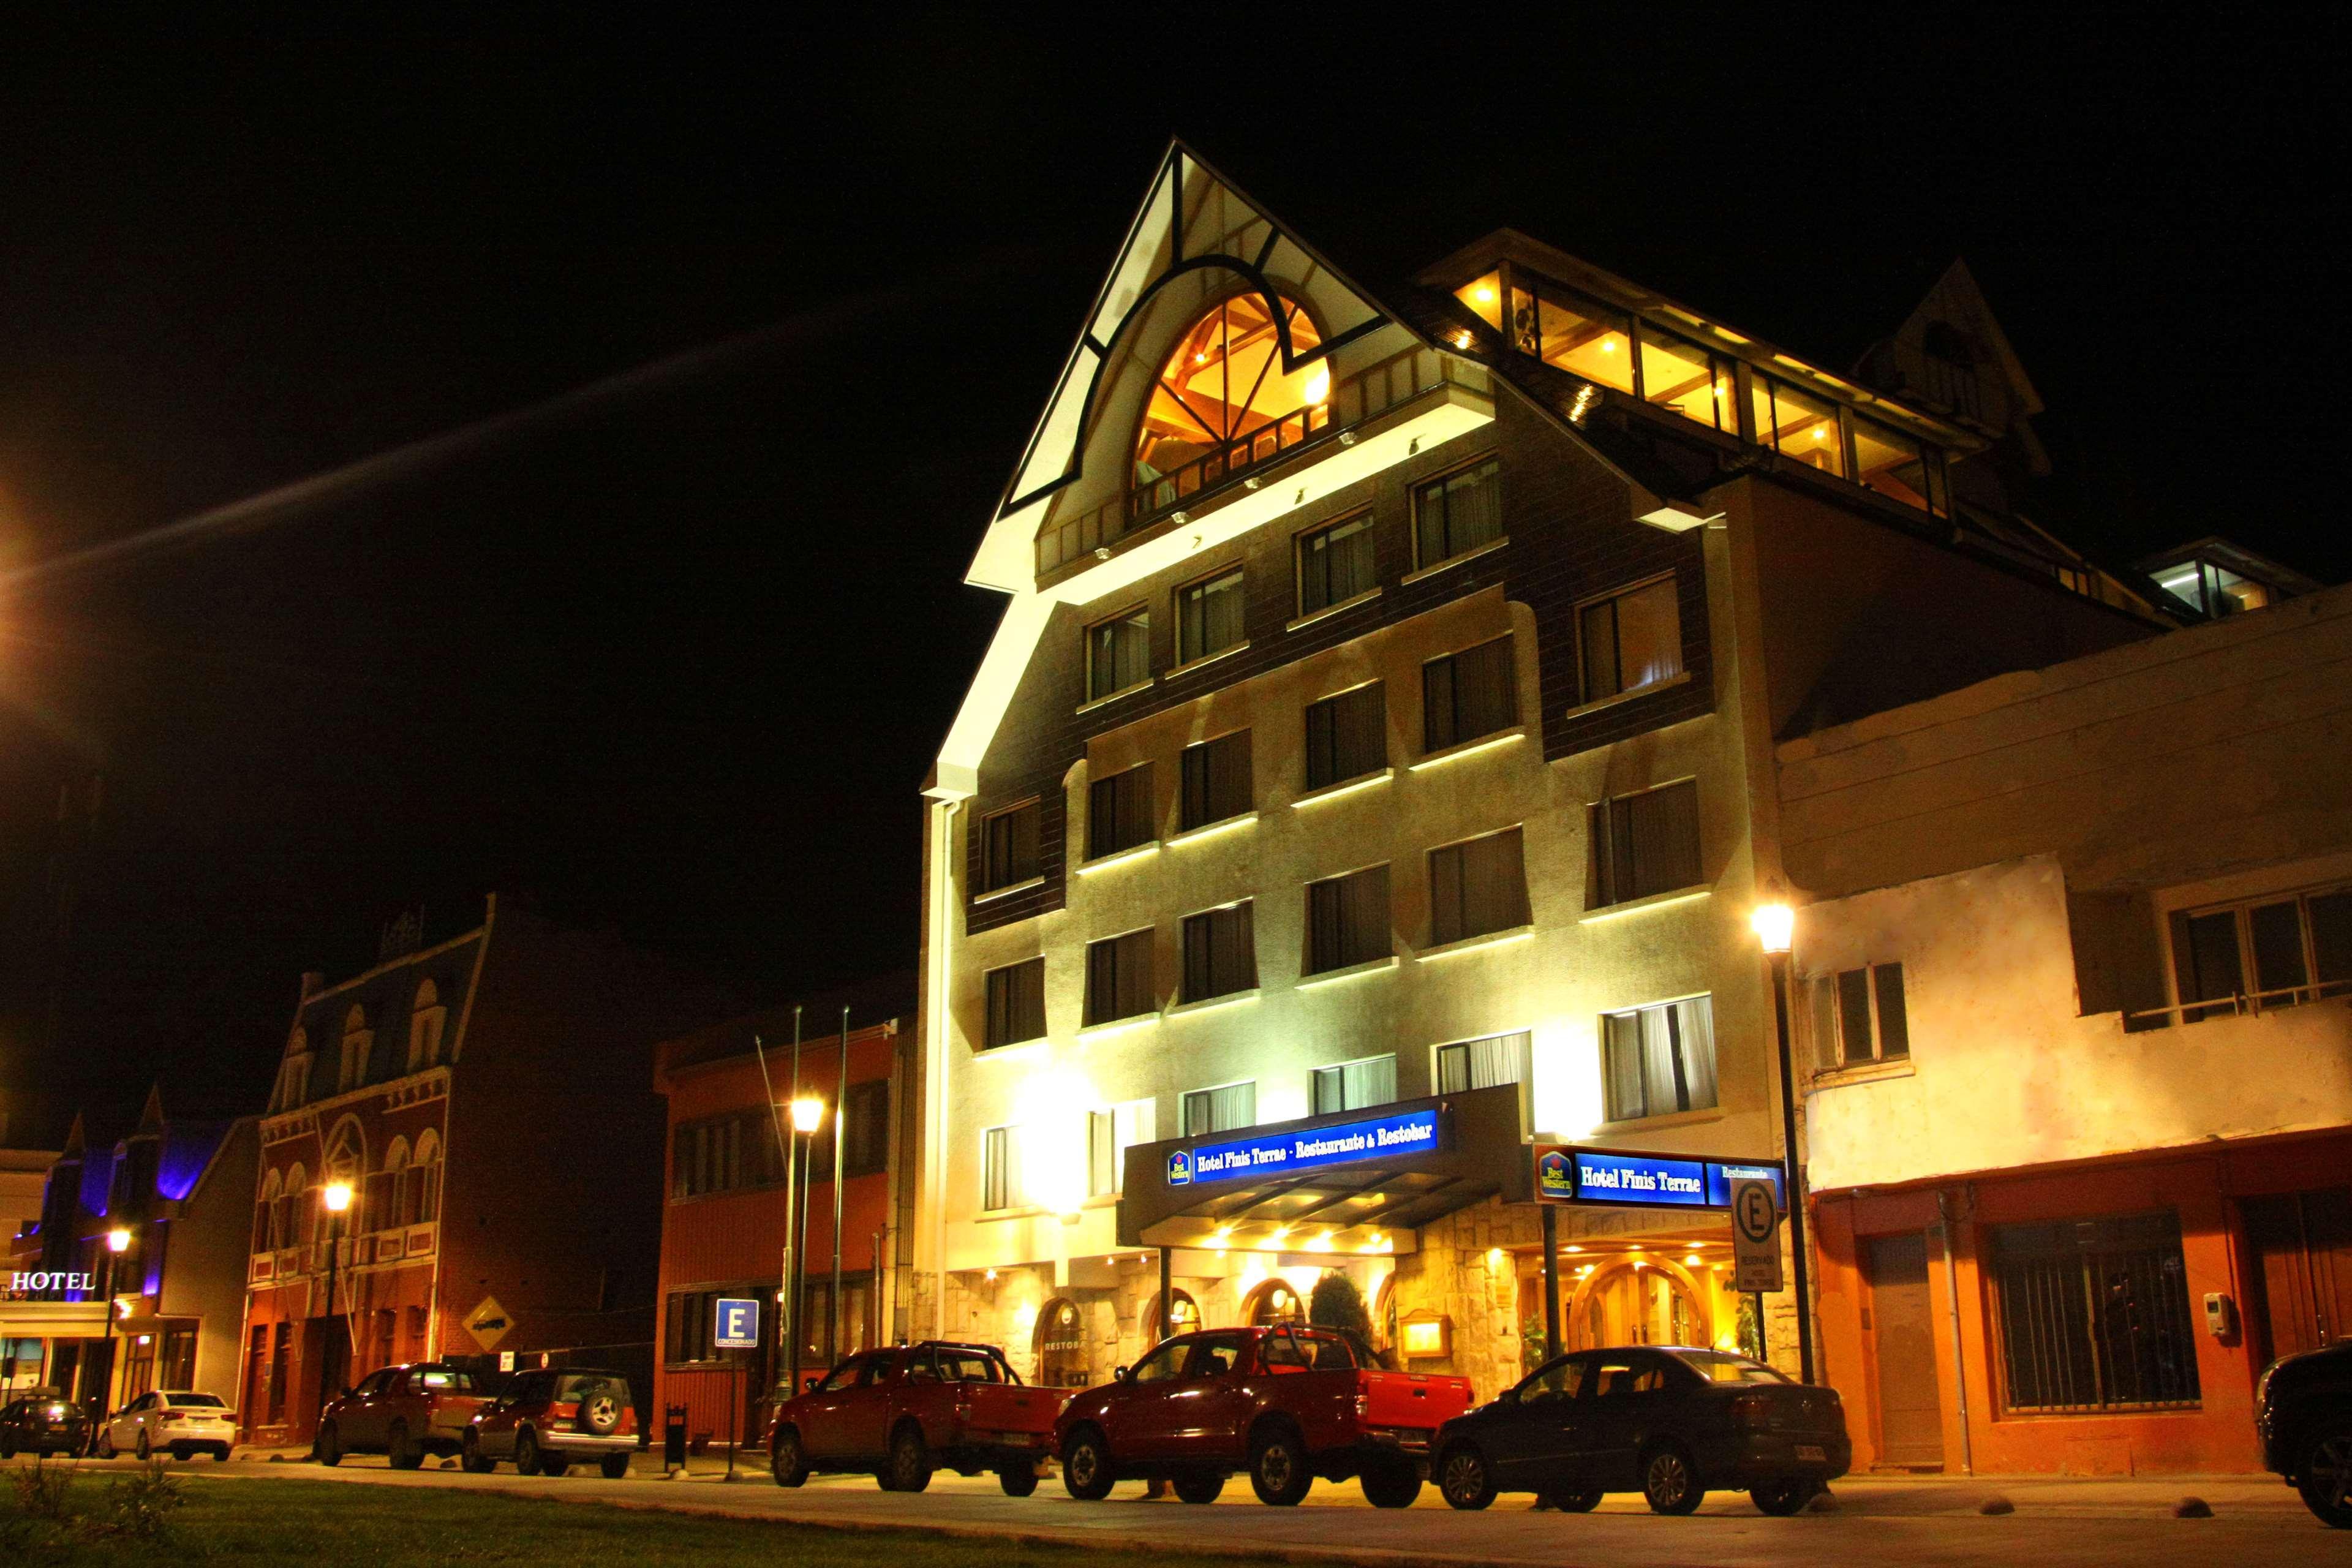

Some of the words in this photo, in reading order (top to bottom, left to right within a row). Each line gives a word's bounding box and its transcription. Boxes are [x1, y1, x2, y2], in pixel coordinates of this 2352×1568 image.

[1197, 1153, 1224, 1173] Hotel
[1224, 1150, 1251, 1169] Finis
[1251, 1148, 1287, 1165] Terrae
[1295, 1133, 1365, 1159] Restaurante
[1366, 1133, 1376, 1149] &
[1377, 1123, 1433, 1147] Restobar
[1174, 1163, 1184, 1172] Best
[1547, 1167, 1563, 1179] Best
[1542, 1176, 1571, 1189] Western
[1580, 1166, 1619, 1188] Hotel
[1620, 1169, 1656, 1190] Finis
[1657, 1171, 1701, 1193] Terrae
[1749, 1193, 1765, 1231] E
[10, 1272, 96, 1290] HOTEL
[729, 1308, 745, 1338] E
